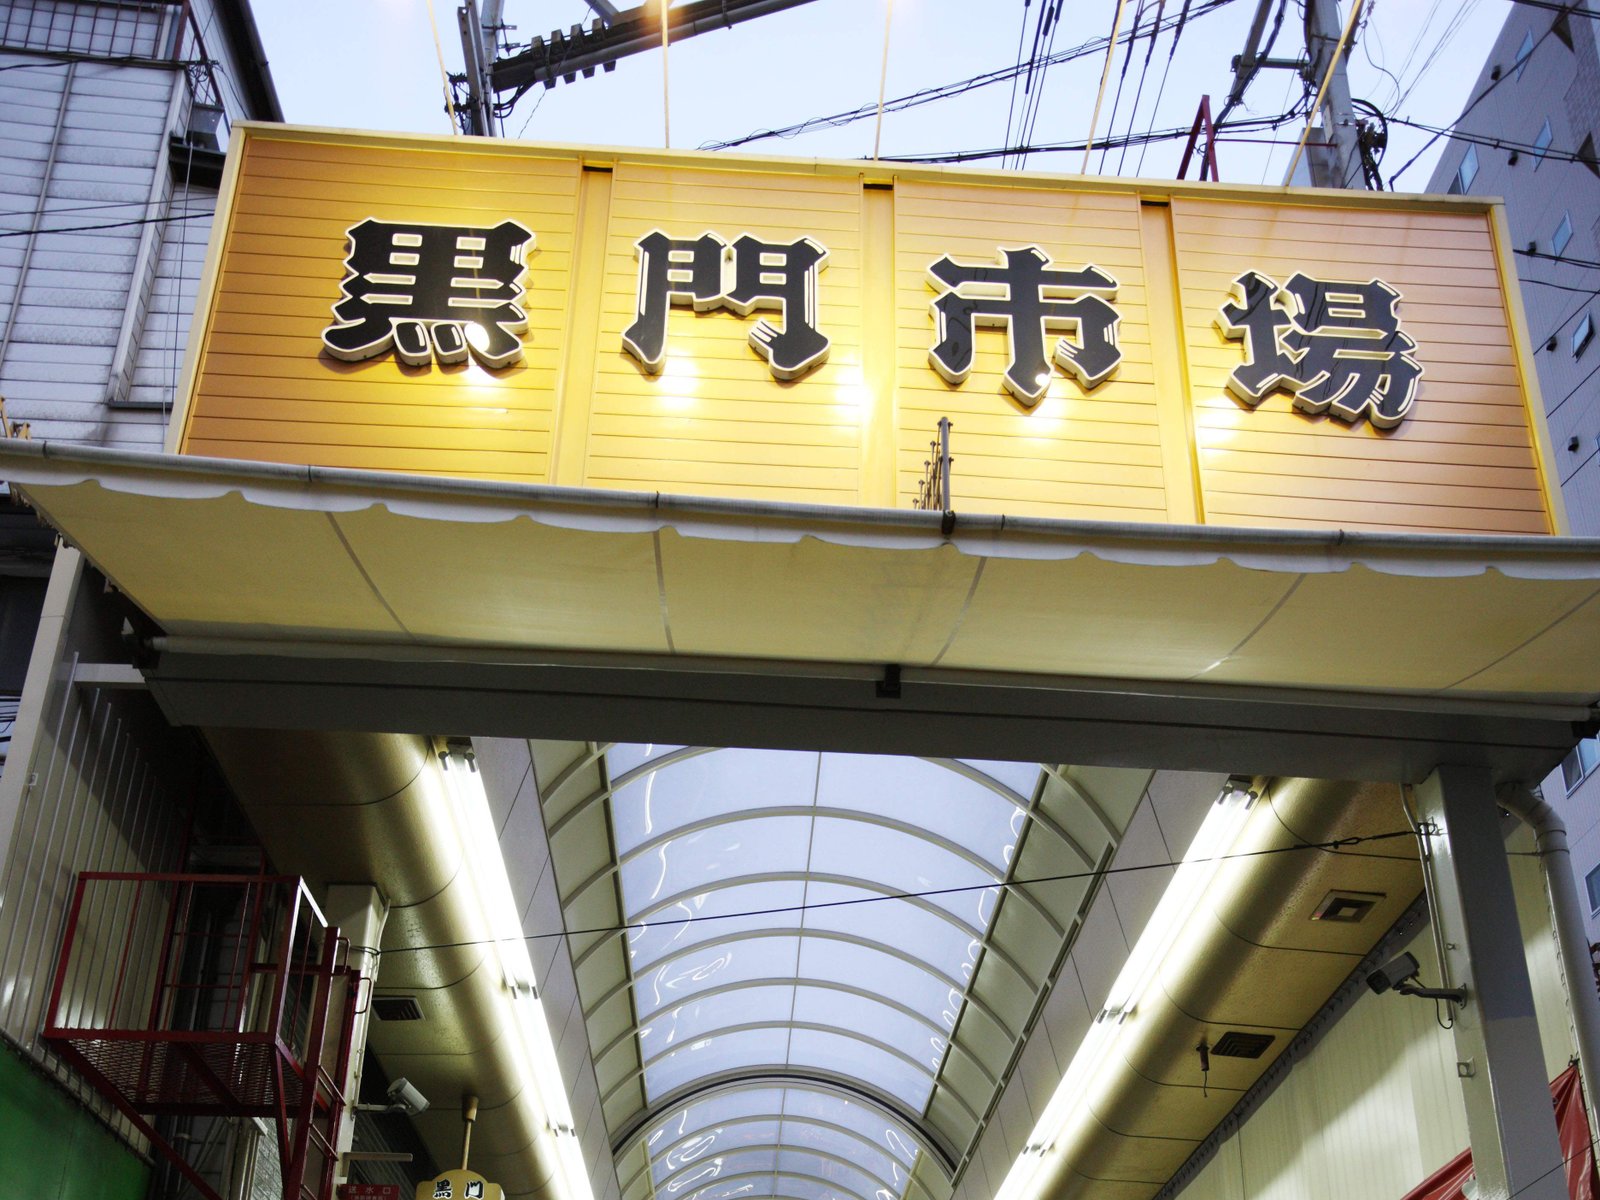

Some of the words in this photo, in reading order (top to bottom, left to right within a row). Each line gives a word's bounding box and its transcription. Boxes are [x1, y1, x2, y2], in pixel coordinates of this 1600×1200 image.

[320, 216, 1424, 431] 黒門市場
[434, 1179, 485, 1199] 黒門
